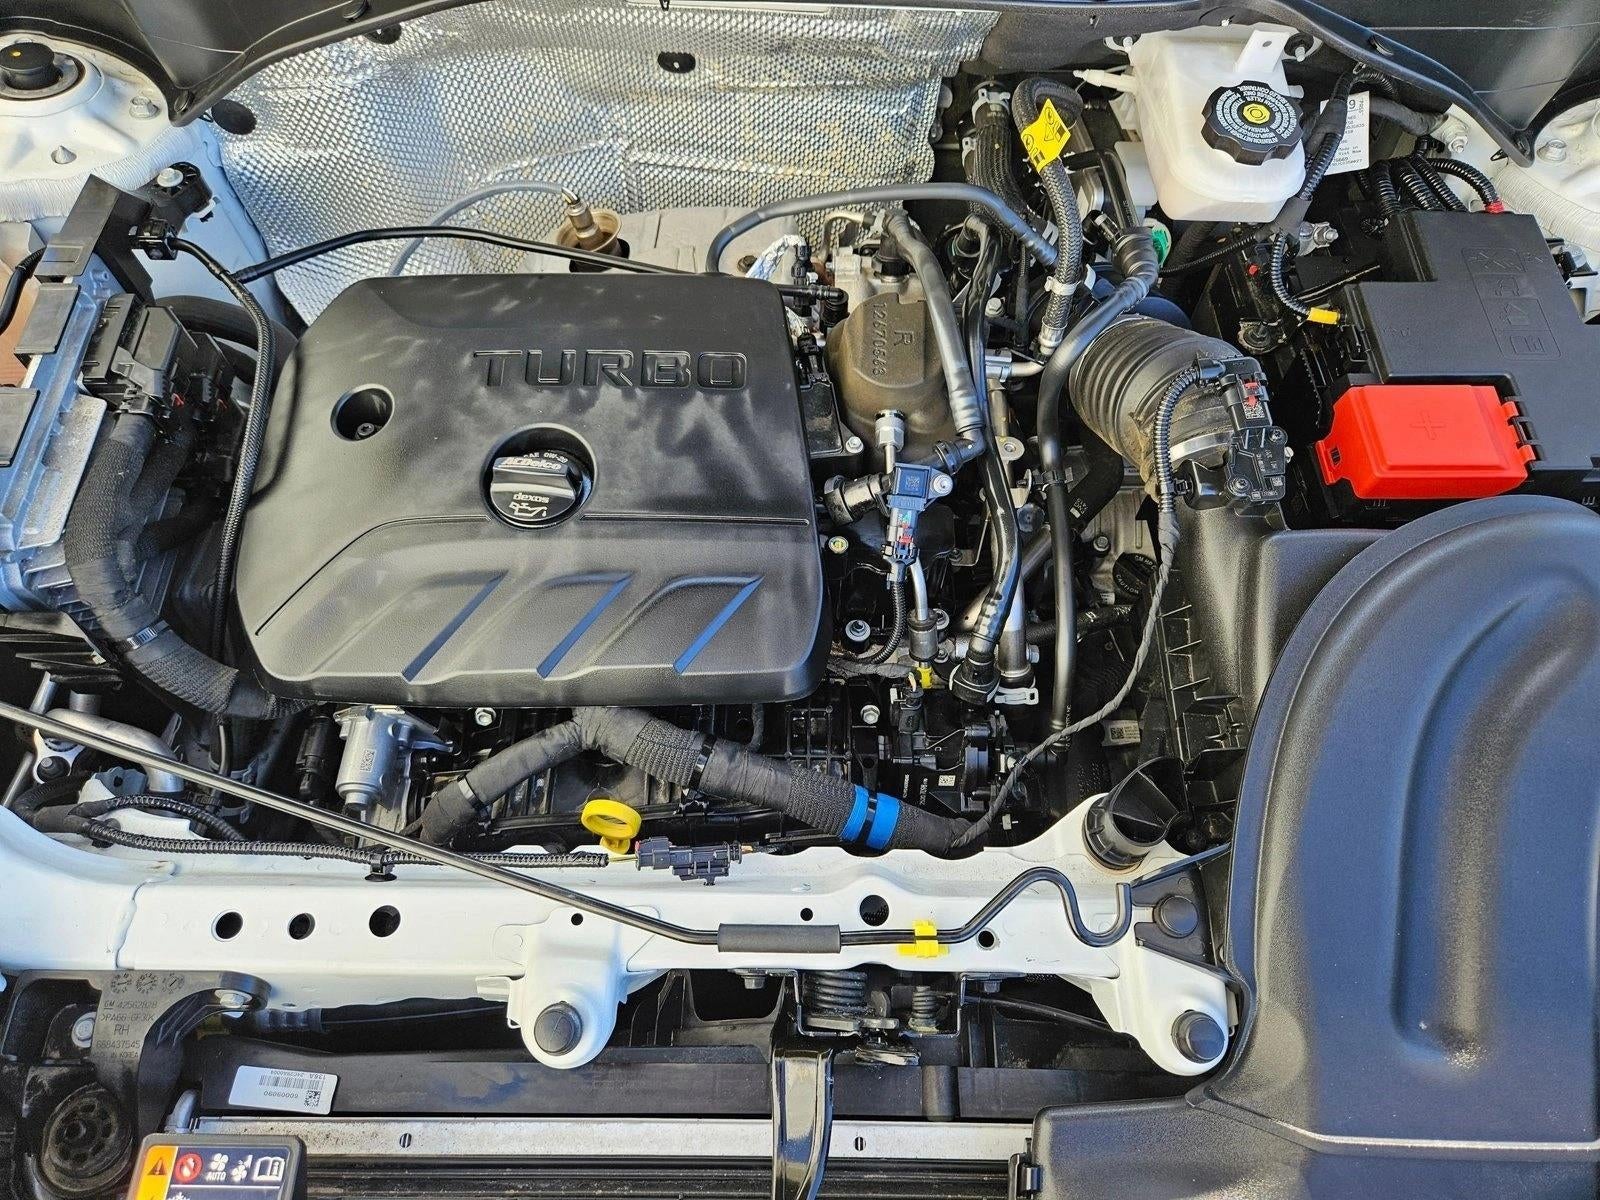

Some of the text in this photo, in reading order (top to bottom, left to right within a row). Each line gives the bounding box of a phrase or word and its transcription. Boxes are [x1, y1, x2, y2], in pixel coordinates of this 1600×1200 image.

[473, 349, 747, 389] TURBO
[502, 457, 561, 469] ACDelco
[513, 492, 550, 504] dexos
[1116, 574, 1139, 594] CAUTION
[114, 1024, 130, 1036] RH
[206, 1171, 227, 1181] AUTO
